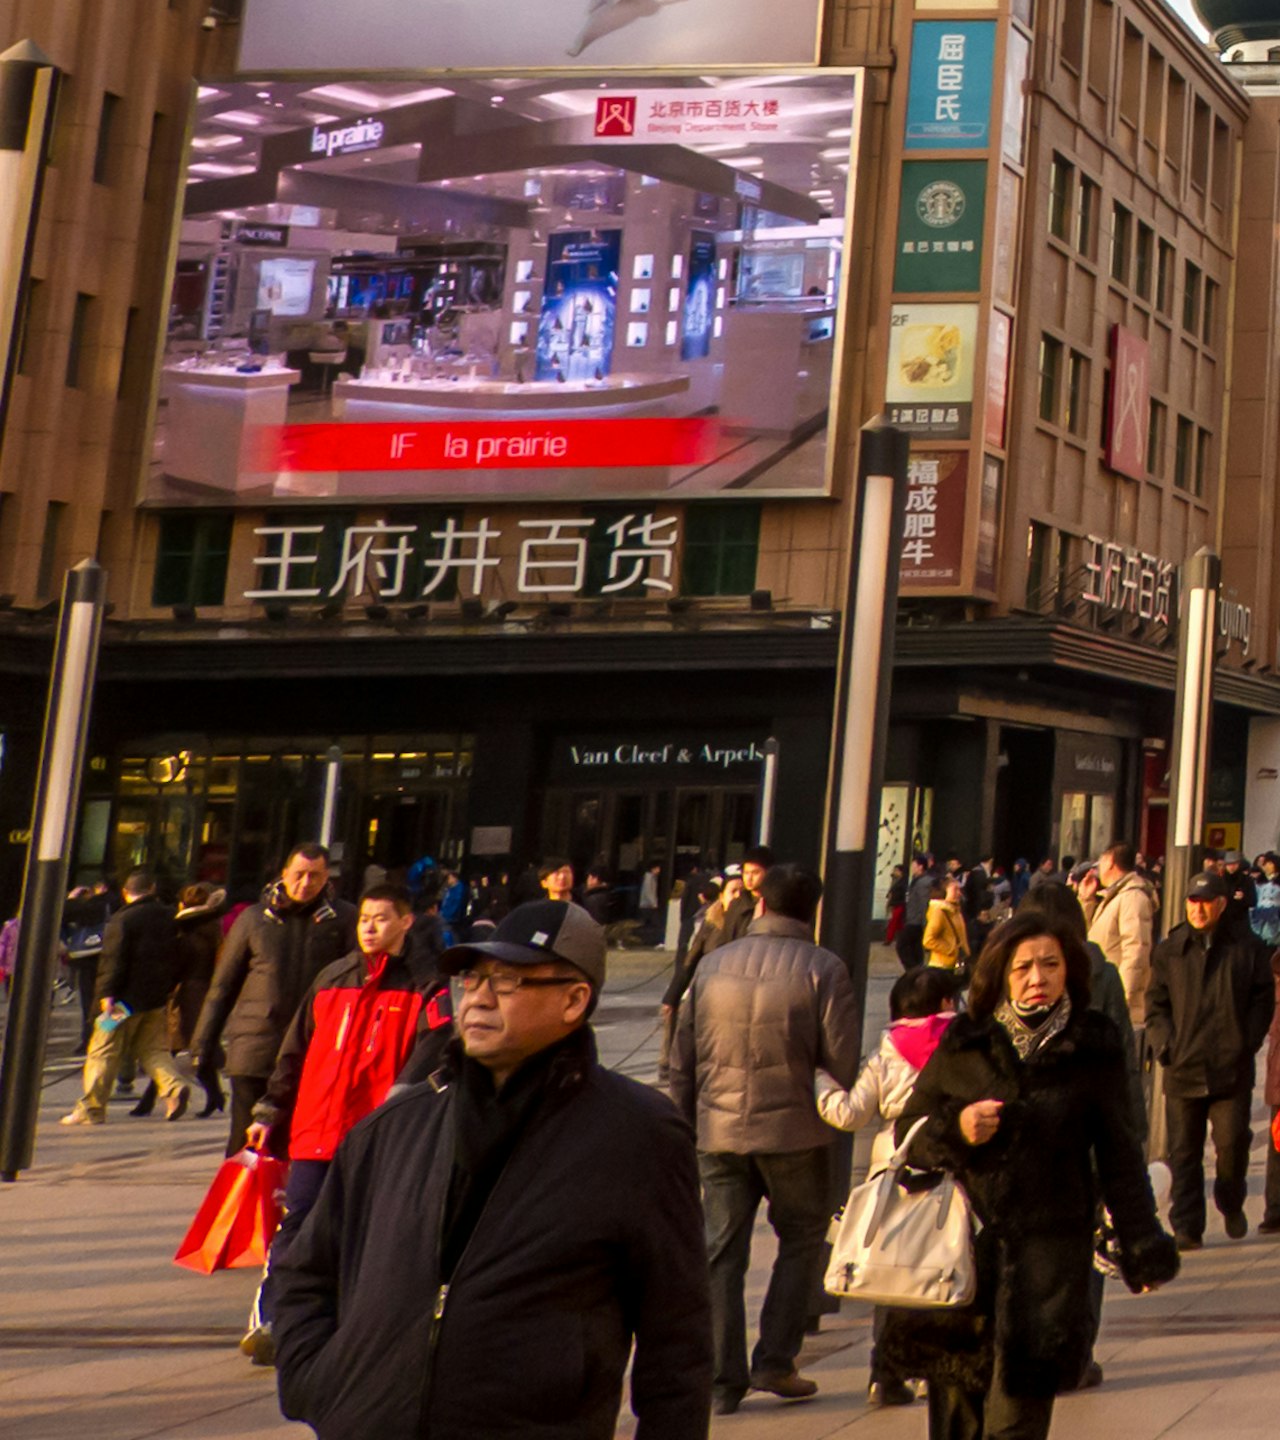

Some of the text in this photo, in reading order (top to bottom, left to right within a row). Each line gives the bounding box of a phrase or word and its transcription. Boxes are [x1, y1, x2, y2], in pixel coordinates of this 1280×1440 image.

[936, 34, 966, 121] 屈臣氏
[650, 100, 780, 119] 北京市百货大楼
[751, 121, 779, 131] Store
[310, 117, 384, 157] la prairie
[892, 315, 909, 326] 2F
[444, 432, 468, 458] la
[476, 431, 567, 464] prairie
[901, 460, 940, 566] 福成肥牛
[243, 515, 678, 598] 王府井百货
[570, 742, 765, 768] Van Cleef & Arpels
